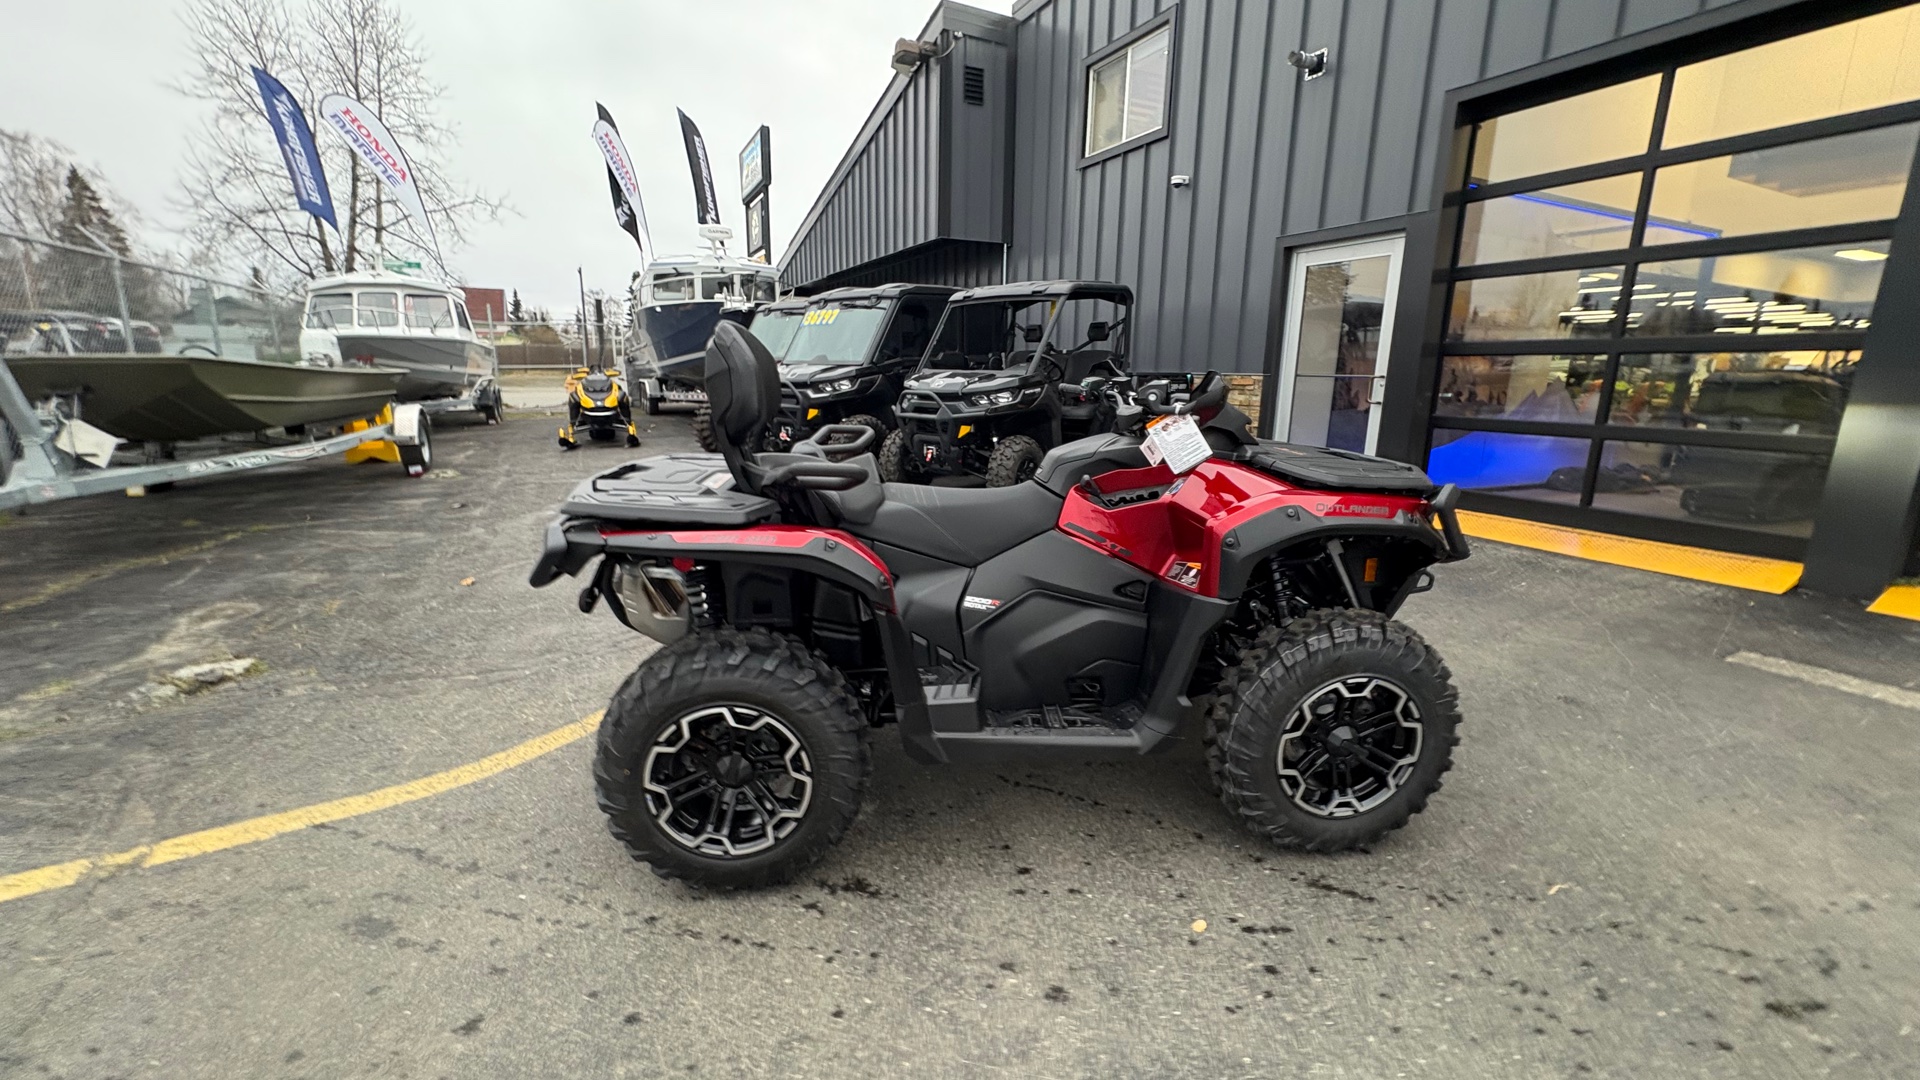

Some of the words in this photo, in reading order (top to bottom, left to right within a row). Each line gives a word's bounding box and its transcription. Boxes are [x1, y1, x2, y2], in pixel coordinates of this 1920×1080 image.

[330, 113, 401, 188] MARINE
[340, 106, 407, 183] HONDA
[603, 130, 637, 193] HONDA
[693, 135, 717, 223] KINGFISHER
[1315, 502, 1390, 515] OUTLANDER
